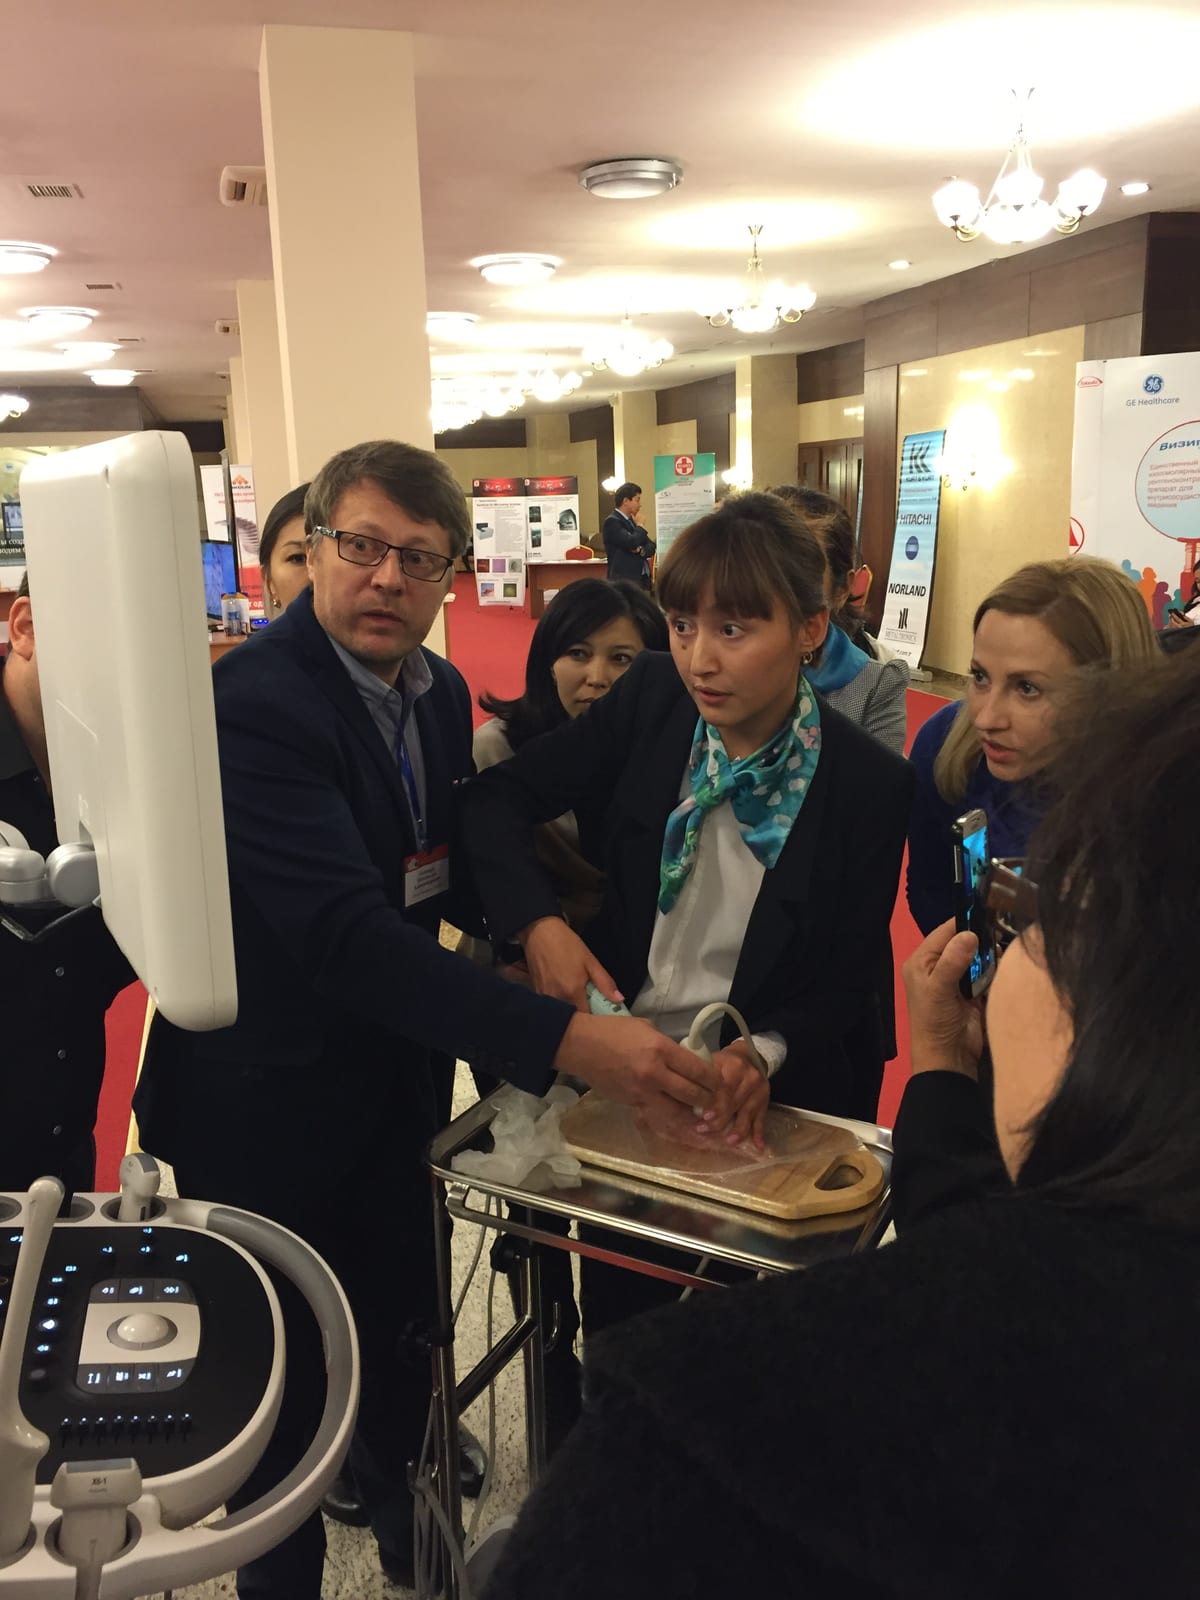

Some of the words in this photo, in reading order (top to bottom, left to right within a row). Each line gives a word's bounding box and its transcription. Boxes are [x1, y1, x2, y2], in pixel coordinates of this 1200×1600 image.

[1138, 397, 1180, 405] Healthcare
[900, 513, 932, 525] HITACHI
[888, 583, 926, 596] NORLAND
